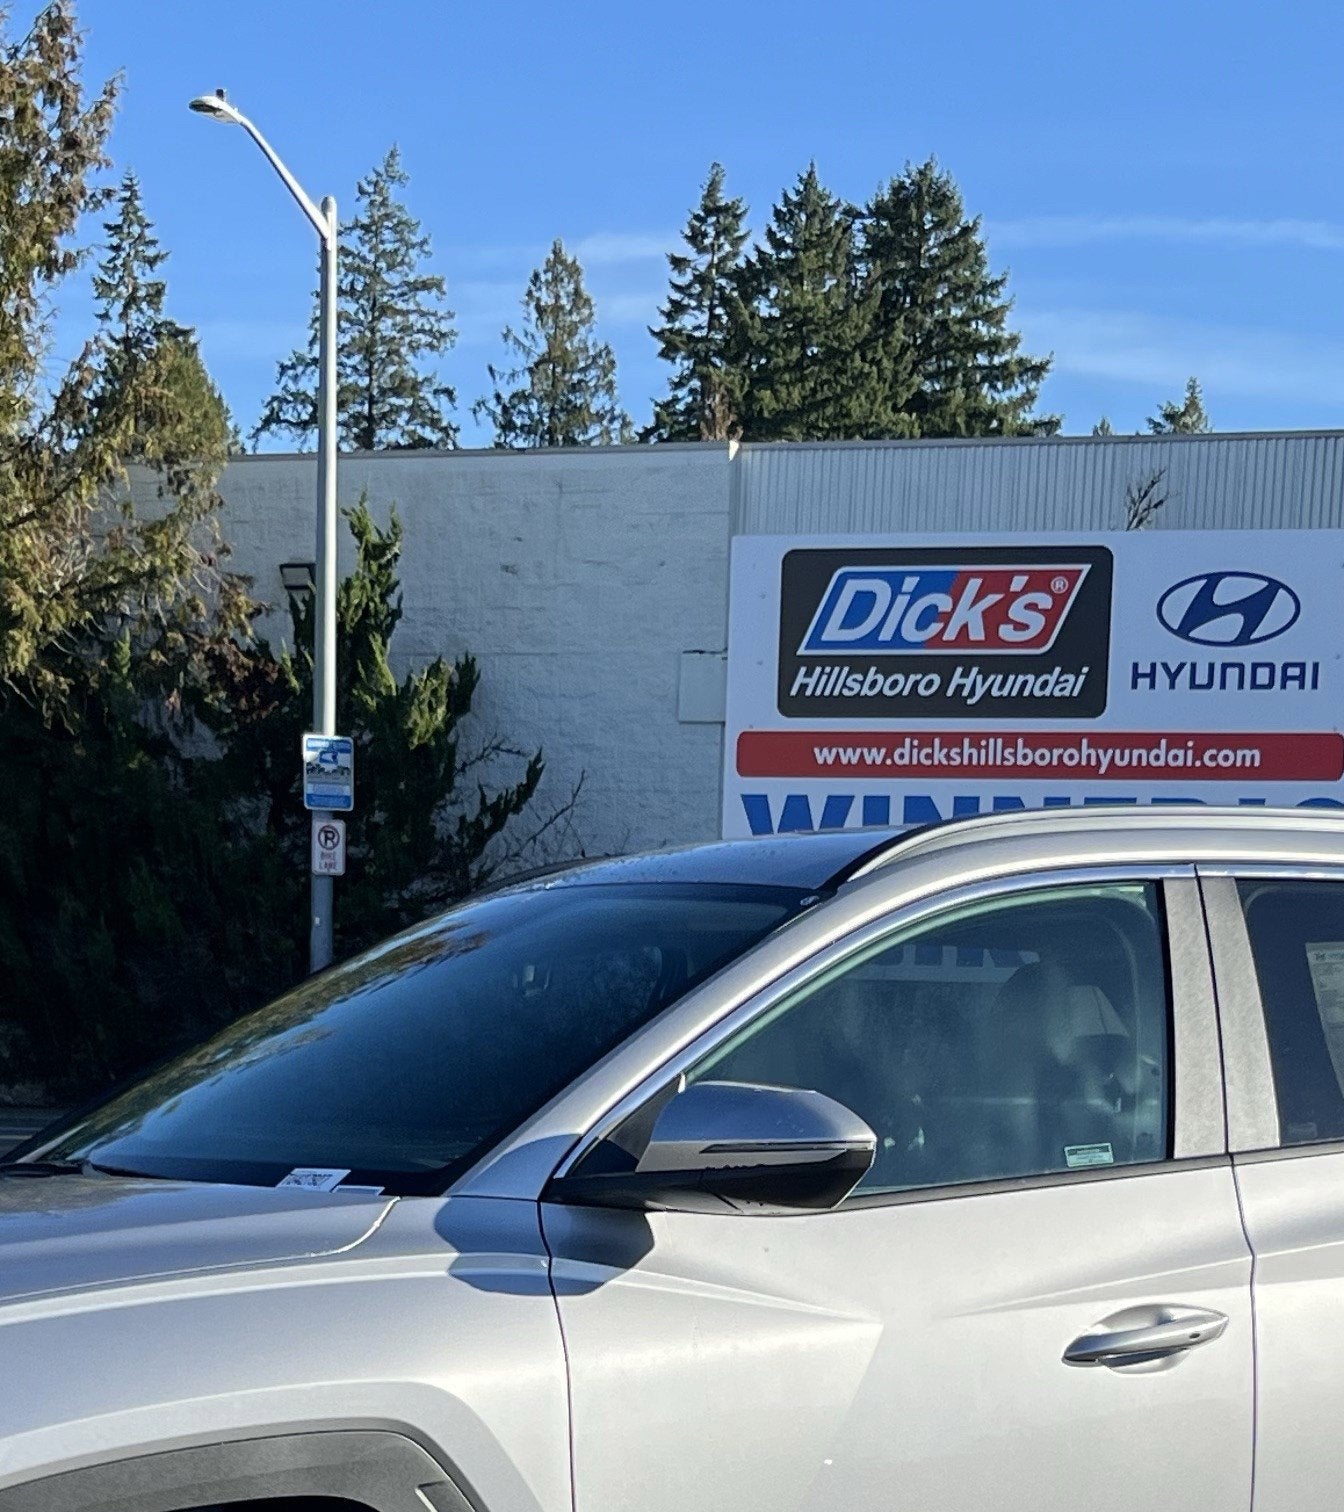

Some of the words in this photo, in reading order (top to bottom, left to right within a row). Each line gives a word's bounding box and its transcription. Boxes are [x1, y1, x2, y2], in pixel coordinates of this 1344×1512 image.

[820, 574, 1055, 643] Dick's
[790, 665, 940, 698] Hillsboro
[947, 665, 1089, 704] Hyundai
[1131, 660, 1320, 692] HYUNDAI
[812, 737, 1261, 775] www.dickshillsborohyundai.com
